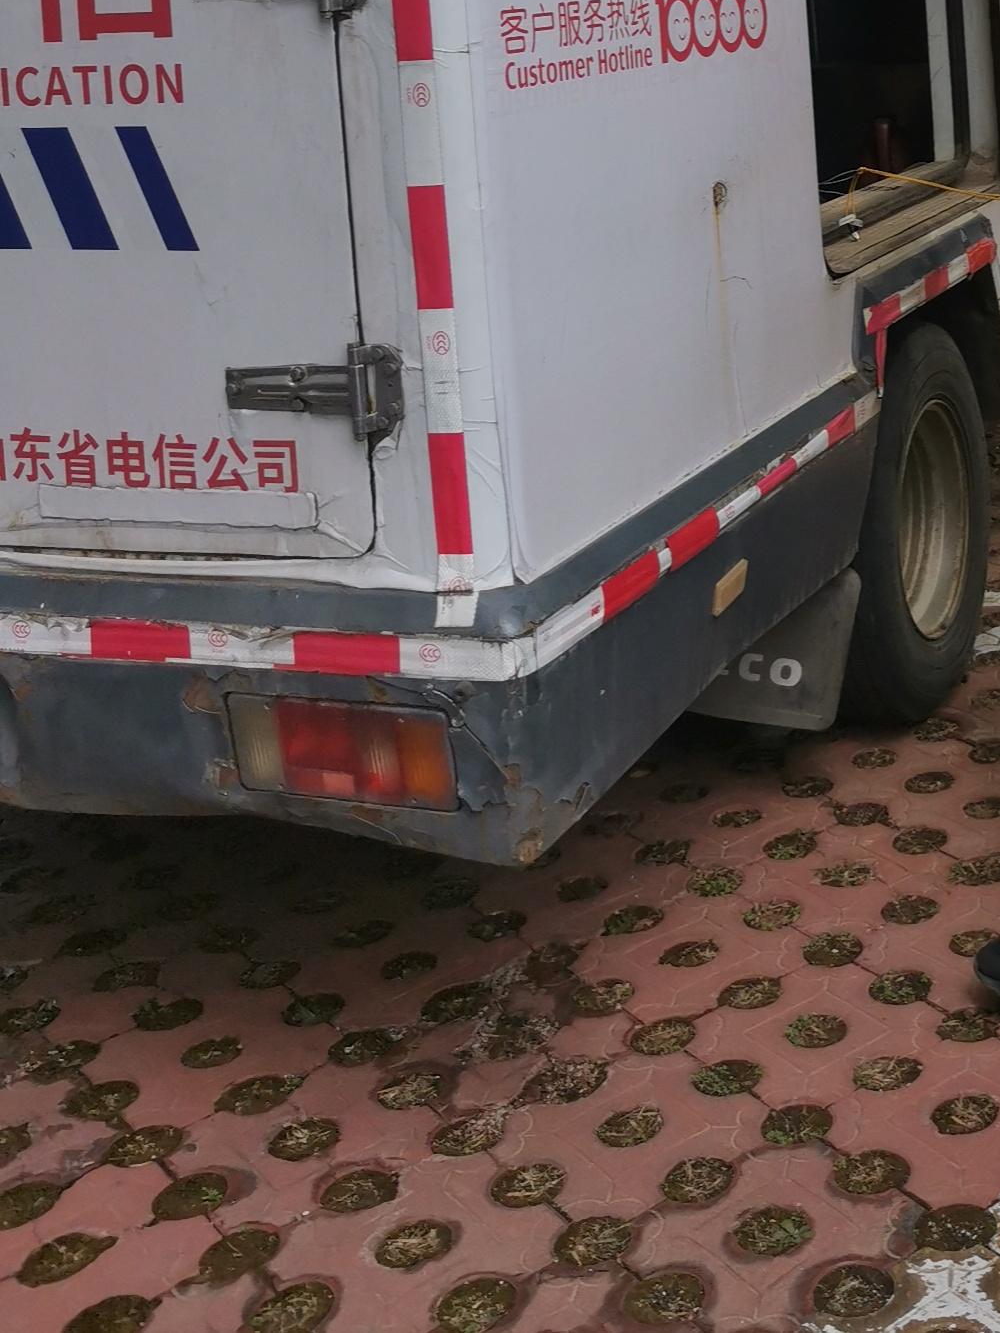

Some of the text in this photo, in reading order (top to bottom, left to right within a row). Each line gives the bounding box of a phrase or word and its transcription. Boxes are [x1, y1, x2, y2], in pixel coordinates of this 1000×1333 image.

[0, 63, 184, 107] ICATION
[505, 43, 653, 90] Customer Hotline
[0, 427, 299, 493] 东省电信公司
[718, 652, 803, 687] CO
